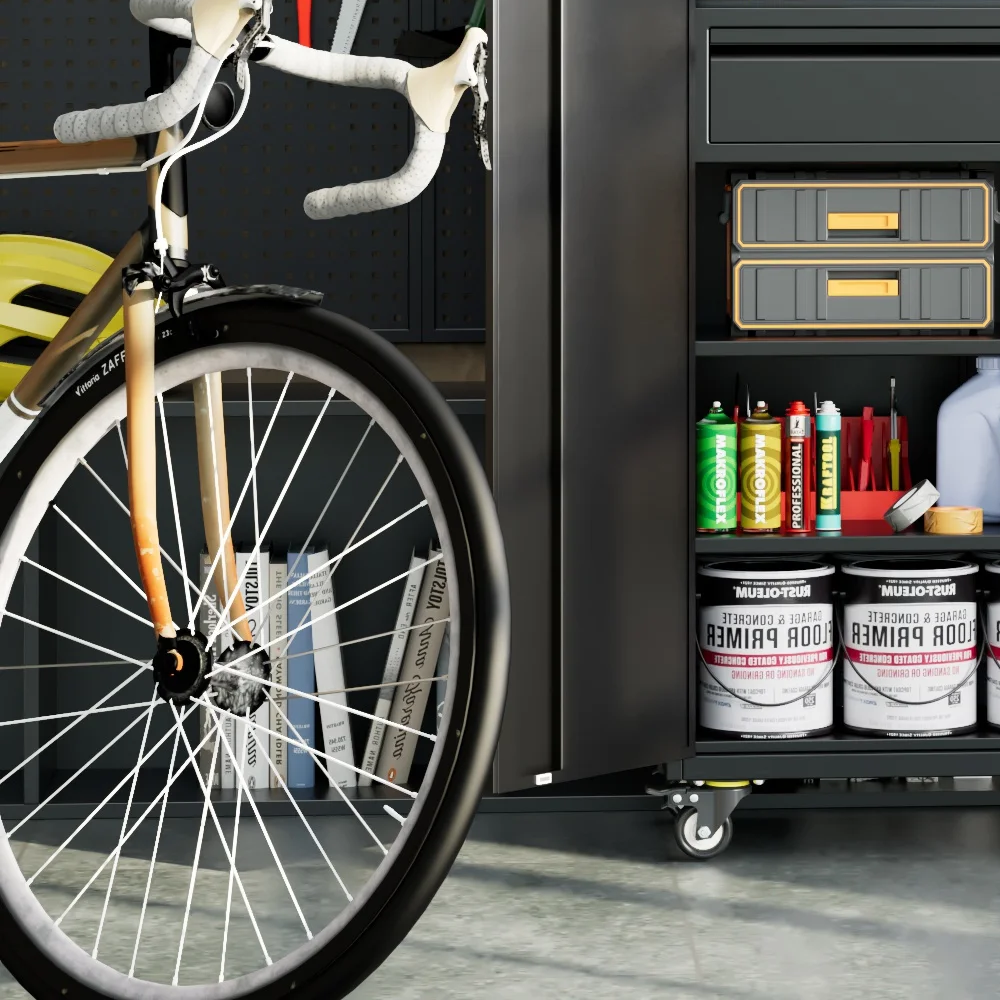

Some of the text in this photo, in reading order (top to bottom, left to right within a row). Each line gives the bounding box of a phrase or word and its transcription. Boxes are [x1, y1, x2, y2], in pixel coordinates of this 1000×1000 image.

[75, 350, 126, 397] Vittoria ZAFF
[715, 434, 727, 524] MAKROFLEX
[755, 434, 766, 524] MAKROFLEX
[791, 443, 802, 529] PROFESSIONAL
